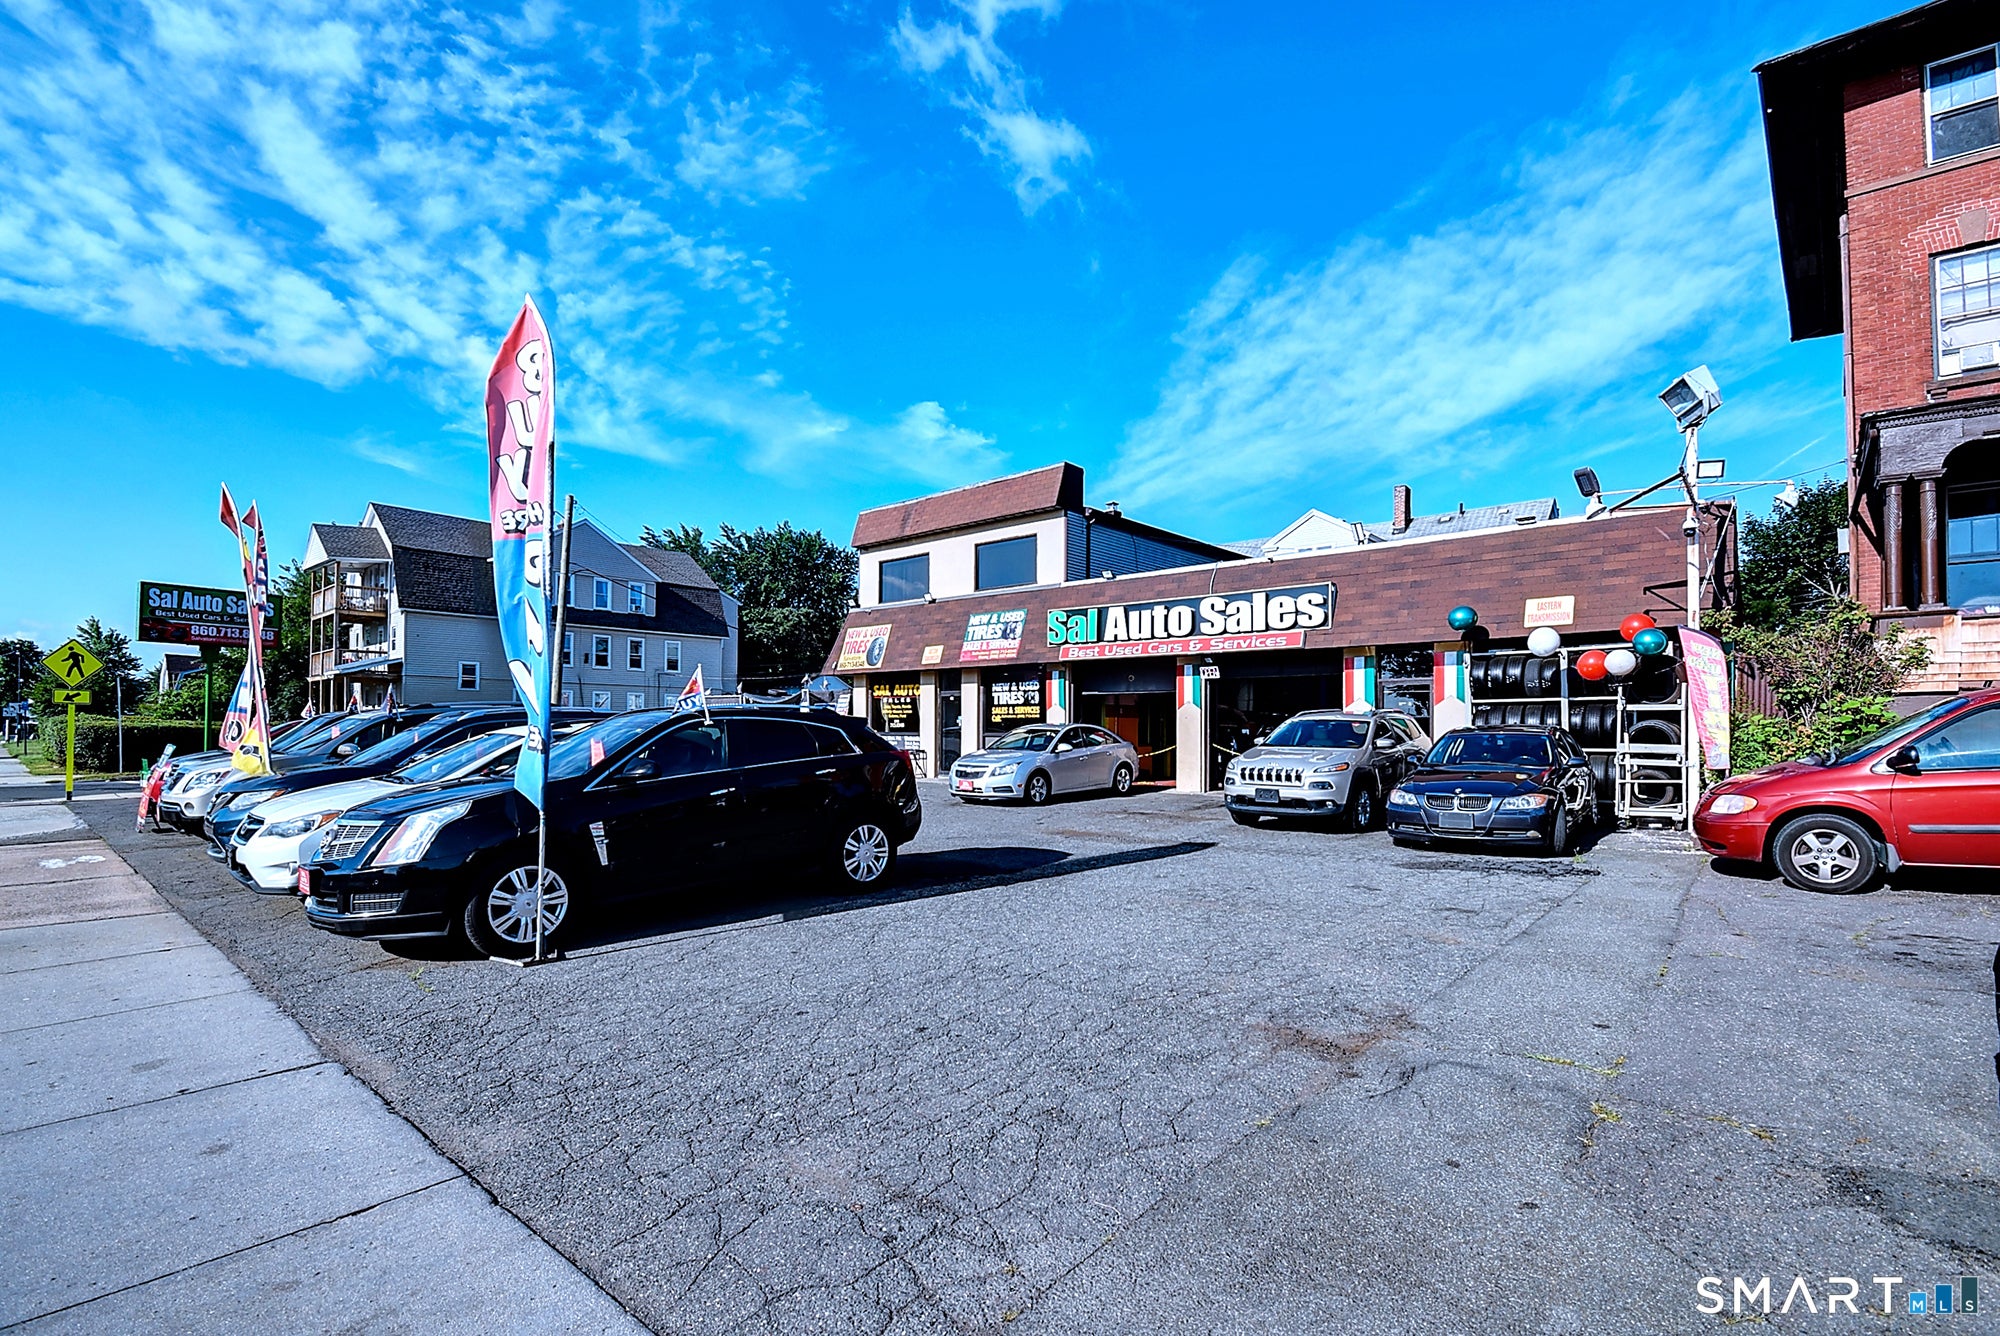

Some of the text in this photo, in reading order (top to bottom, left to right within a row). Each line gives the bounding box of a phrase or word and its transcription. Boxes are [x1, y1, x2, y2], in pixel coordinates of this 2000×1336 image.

[148, 587, 275, 617] Sal Auto Sas
[155, 609, 175, 617] Best
[178, 611, 200, 620] Used
[202, 613, 221, 621] Cars
[968, 611, 1025, 626] NEW & USED
[1048, 591, 1328, 644] Sal Auto Sales
[190, 625, 274, 641] 860.713.848
[869, 627, 889, 637] USED
[966, 623, 1004, 641] TIRES
[844, 640, 870, 655] TIRES
[1067, 636, 1288, 658] Best Used Cars & Services
[873, 684, 921, 696] SAL AUTO
[992, 681, 1040, 692] NEW & USED
[991, 691, 1025, 705] TIRES
[991, 706, 1008, 714] SALES
[1014, 705, 1040, 714] SERVICES
